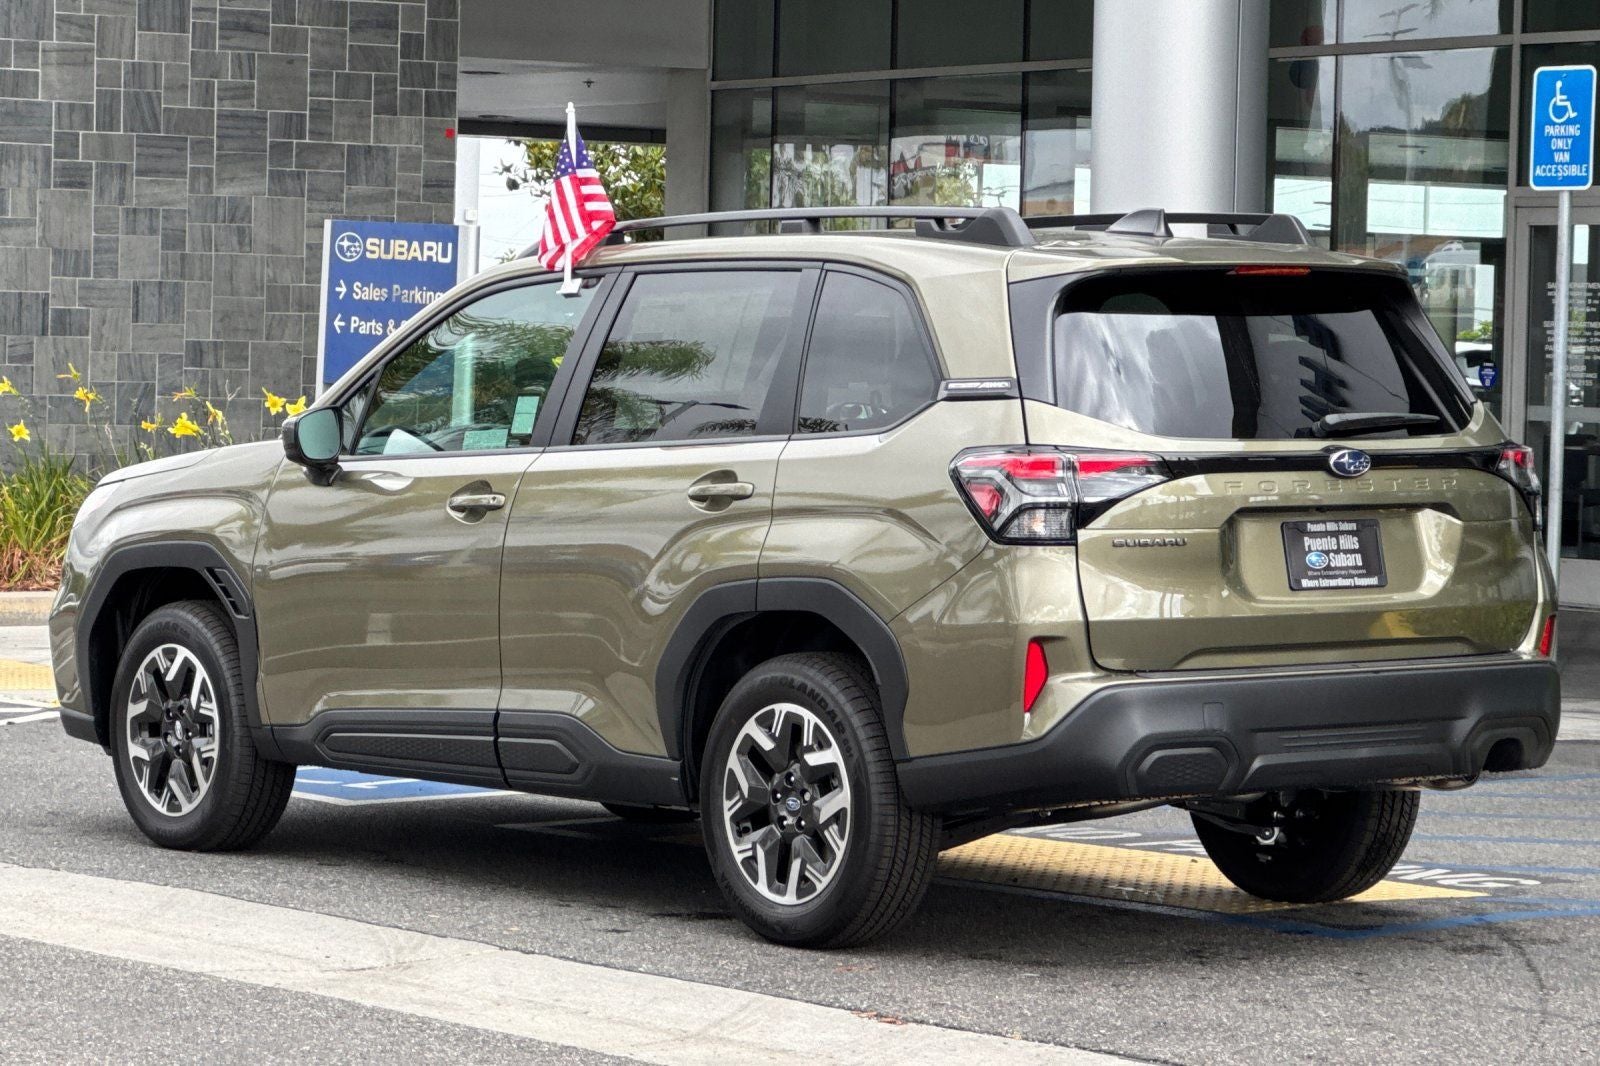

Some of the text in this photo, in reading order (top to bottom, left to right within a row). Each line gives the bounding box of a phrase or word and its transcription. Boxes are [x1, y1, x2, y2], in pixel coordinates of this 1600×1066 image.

[1544, 124, 1580, 137] PARKING
[1551, 138, 1573, 150] ONLY
[1553, 151, 1570, 163] VAN
[1535, 164, 1588, 177] ACCESSIBLE
[365, 237, 453, 264] SUBARU
[352, 281, 388, 301] Sales
[350, 316, 383, 336] Parts
[386, 318, 397, 336] &
[1223, 477, 1458, 496] FORESTER
[1338, 521, 1357, 530] Subaru
[1112, 537, 1188, 548] SUBARU
[1303, 533, 1359, 551] Puente Hills
[1329, 552, 1363, 568] Subaru
